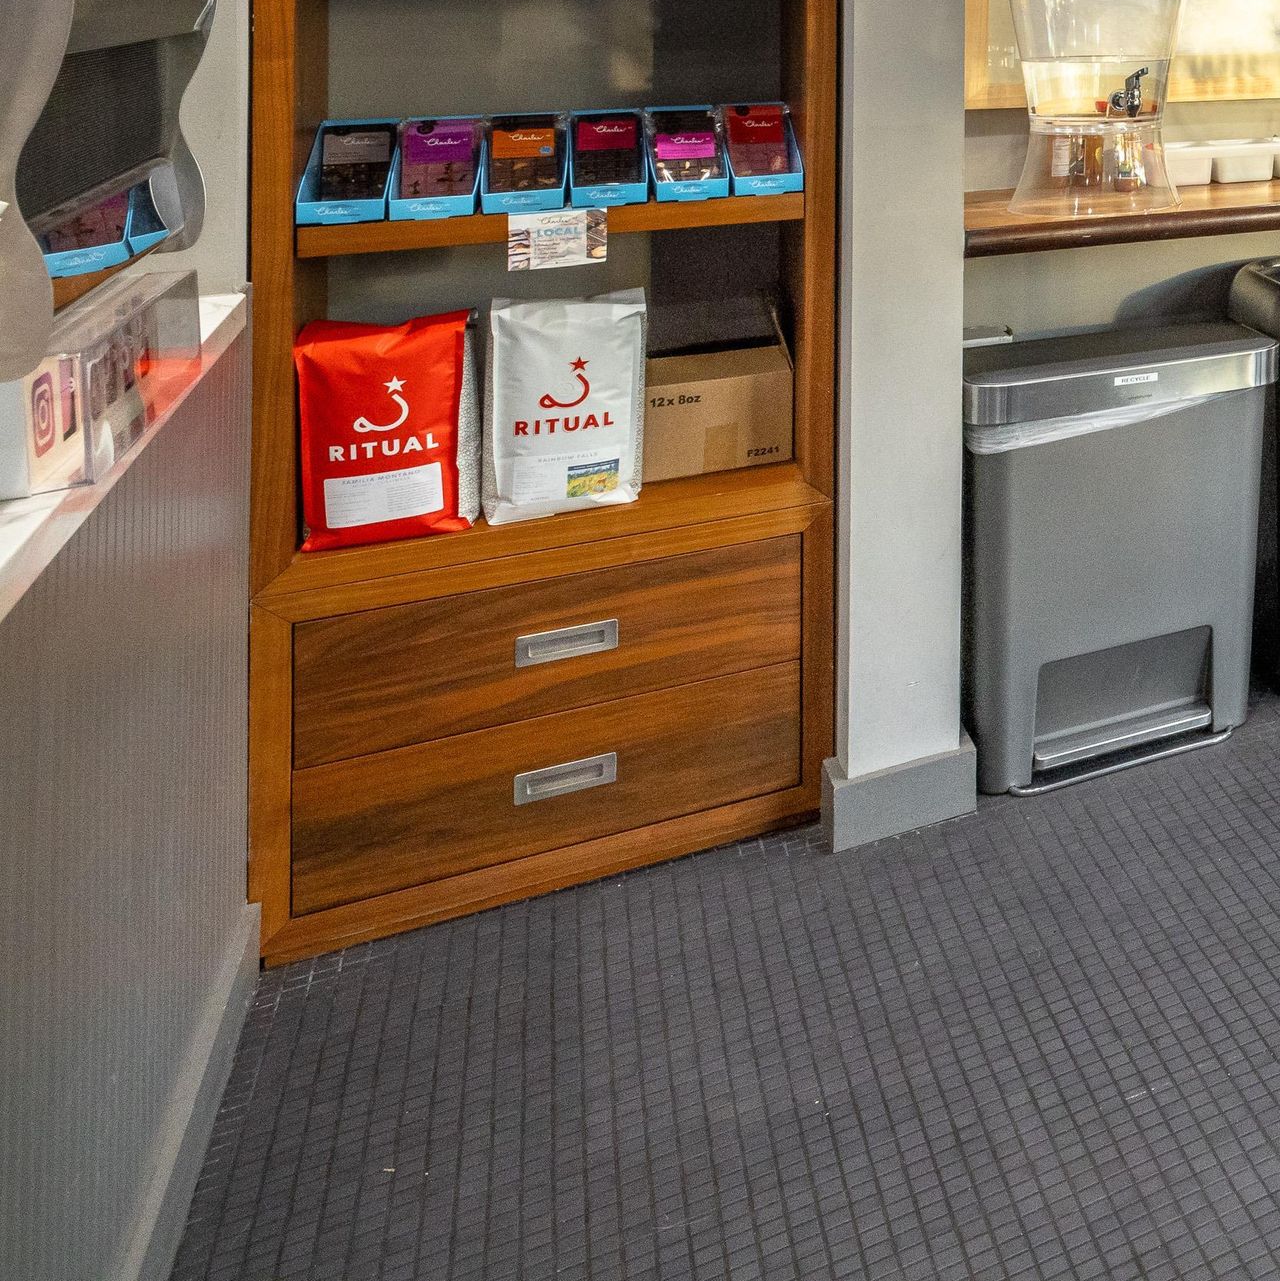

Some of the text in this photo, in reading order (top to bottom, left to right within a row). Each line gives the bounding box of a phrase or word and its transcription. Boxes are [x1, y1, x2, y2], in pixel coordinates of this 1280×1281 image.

[537, 226, 580, 238] LOCAL
[1121, 375, 1149, 384] RECYCLE
[678, 394, 702, 405] 8oz
[514, 411, 614, 436] RITUAL
[329, 433, 440, 462] RITUAL
[747, 446, 780, 458] F2241
